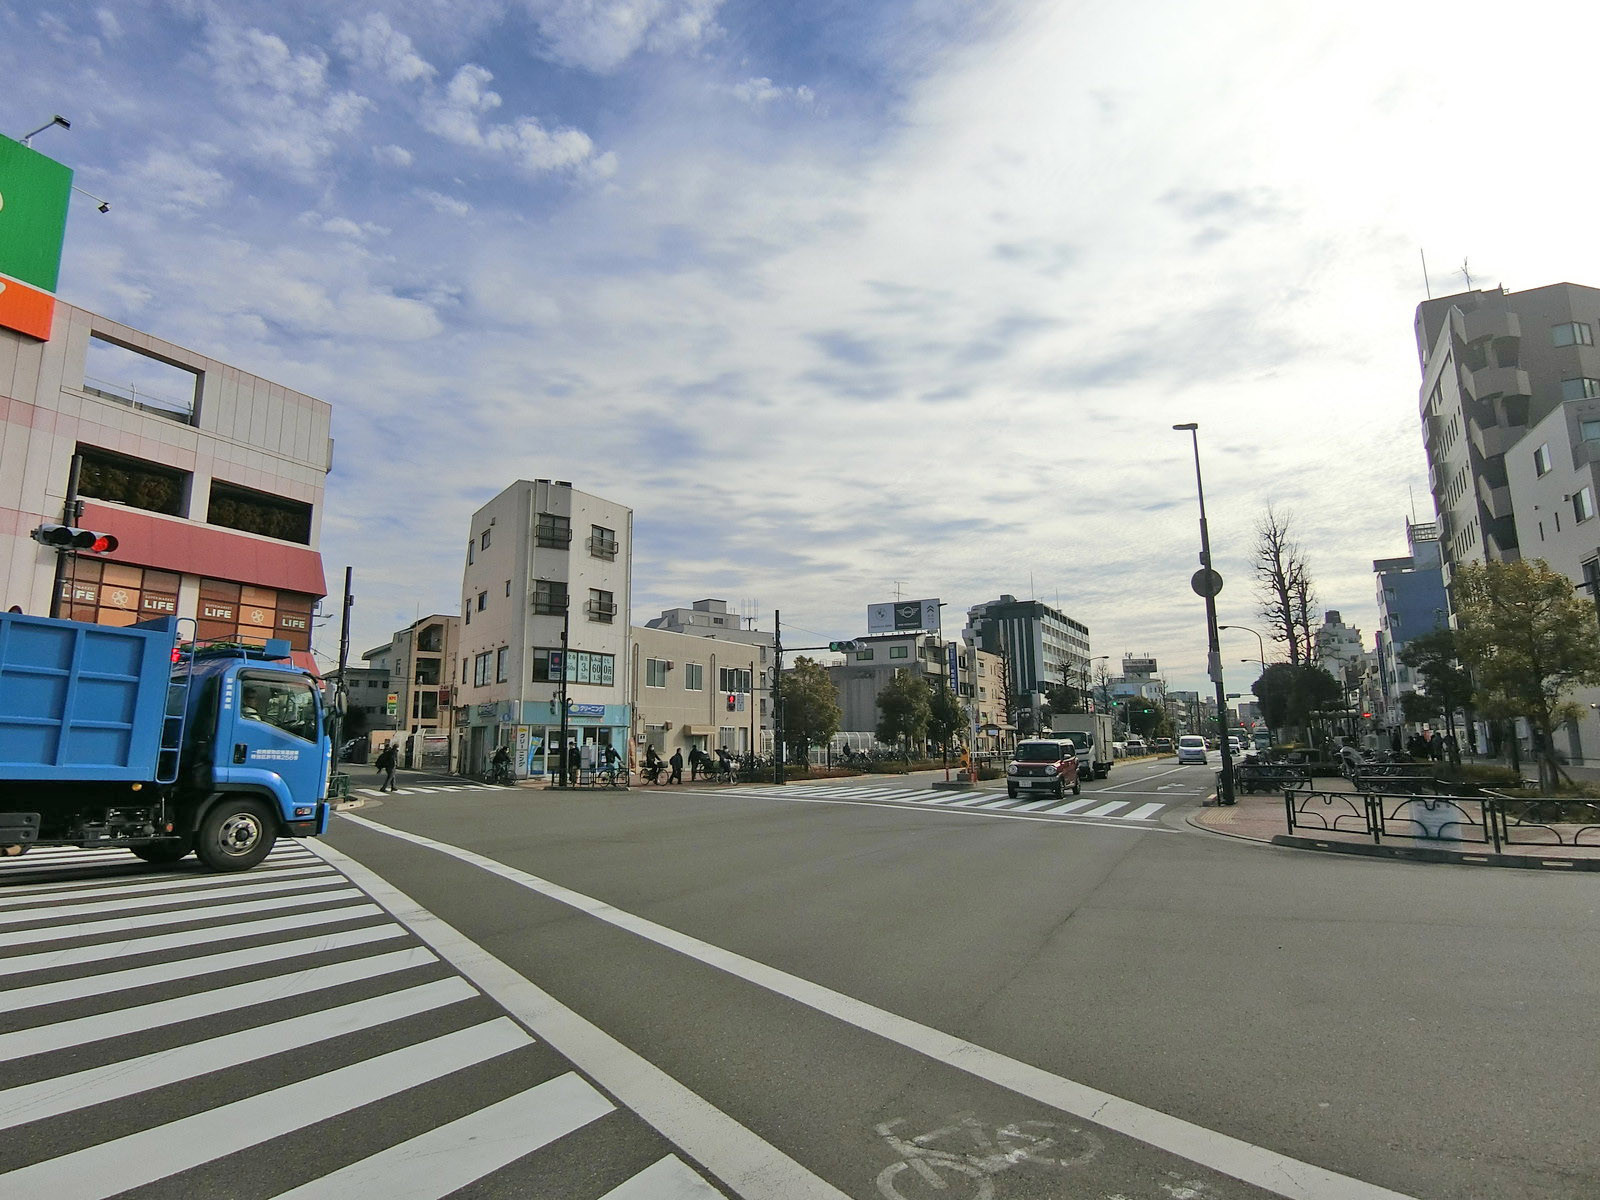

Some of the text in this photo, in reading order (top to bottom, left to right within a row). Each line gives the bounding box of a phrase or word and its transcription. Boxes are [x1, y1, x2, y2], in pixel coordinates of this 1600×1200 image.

[62, 588, 95, 600] LIFE
[144, 599, 174, 611] LIFE
[204, 608, 232, 618] LIFE
[282, 619, 305, 628] LIFE
